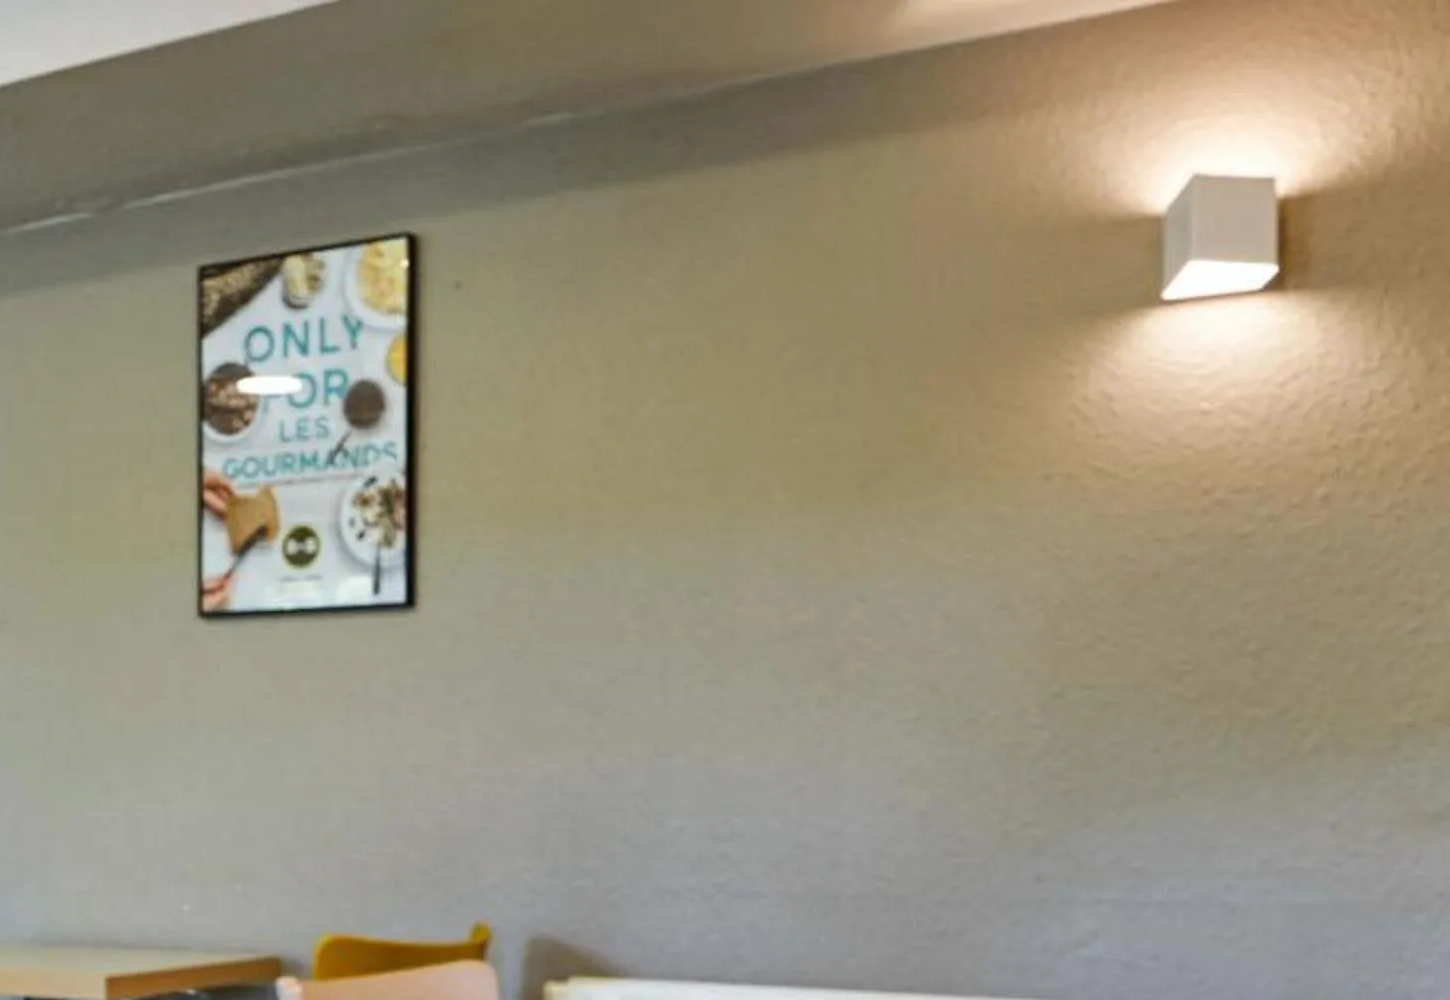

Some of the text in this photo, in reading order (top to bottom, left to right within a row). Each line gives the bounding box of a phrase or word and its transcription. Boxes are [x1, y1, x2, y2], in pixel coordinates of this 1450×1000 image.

[243, 315, 365, 365] ONLY
[261, 368, 350, 414] OR
[278, 415, 330, 443] LES
[222, 440, 398, 479] GOURMANDS
